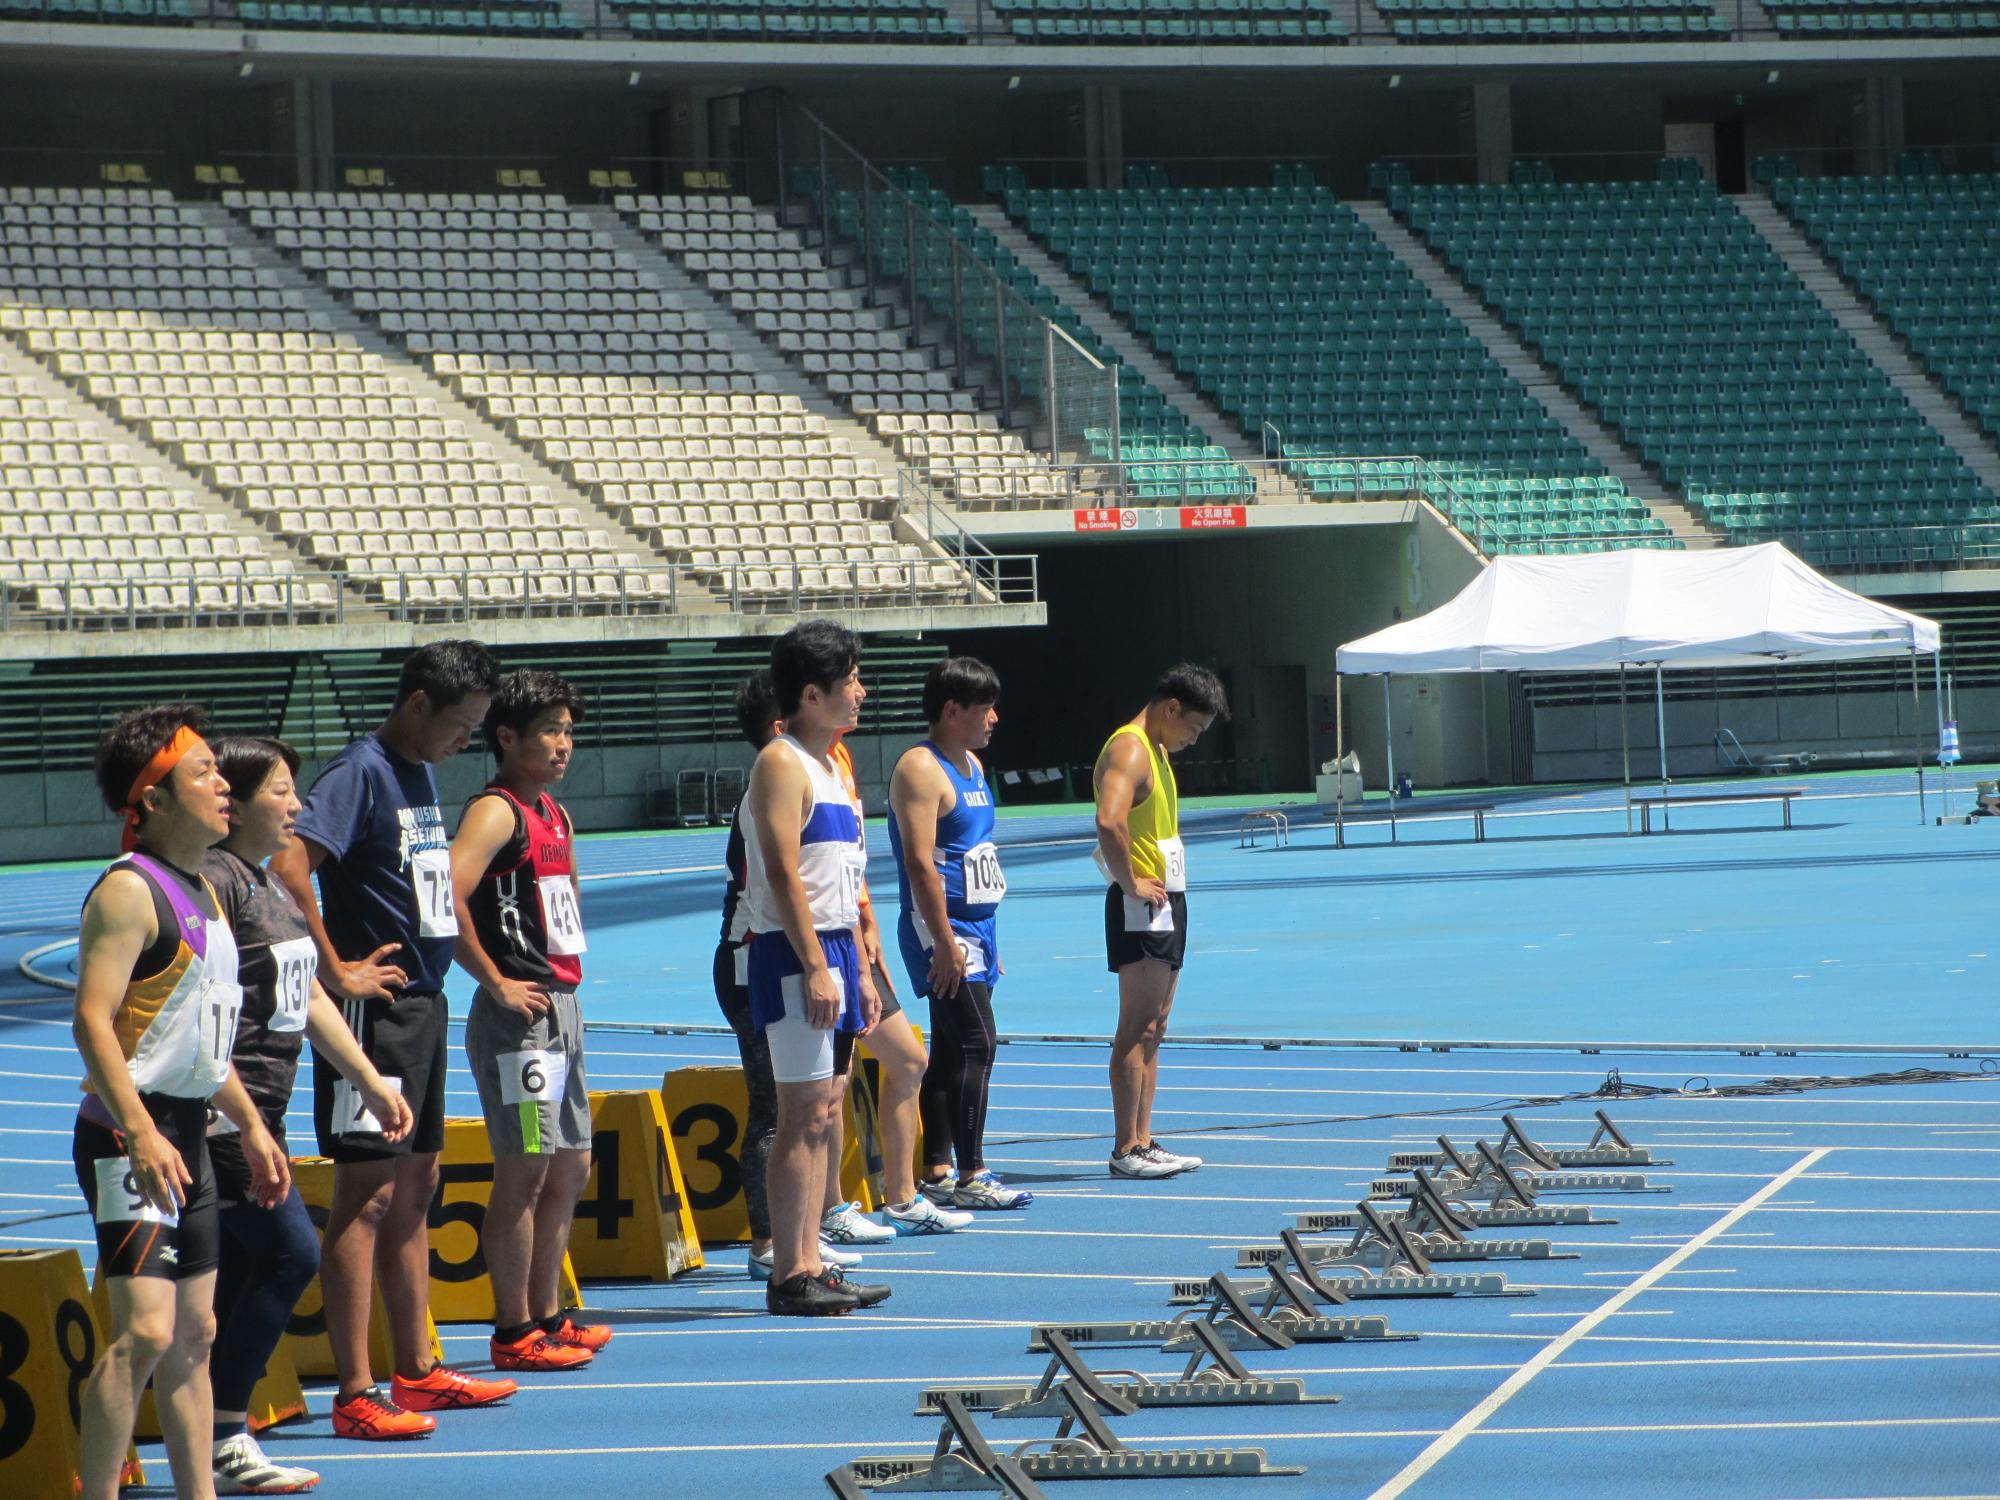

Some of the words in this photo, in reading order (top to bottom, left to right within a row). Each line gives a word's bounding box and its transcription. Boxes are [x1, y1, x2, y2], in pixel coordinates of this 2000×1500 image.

[1087, 510, 1109, 521] 禁煙
[1155, 509, 1163, 528] 3
[1078, 521, 1088, 529] No
[1089, 520, 1118, 530] Smoking
[1191, 518, 1202, 526] No
[1203, 518, 1221, 527] Open
[1222, 518, 1236, 526] Fire
[521, 1058, 546, 1094] 6
[671, 1103, 744, 1210] 3
[1395, 1155, 1433, 1165] NISHI
[574, 1130, 634, 1240] 4
[1372, 1182, 1408, 1192] NISHI
[426, 1162, 494, 1283] 5
[1308, 1216, 1350, 1227] NISHI
[854, 1462, 913, 1478] NISHI
